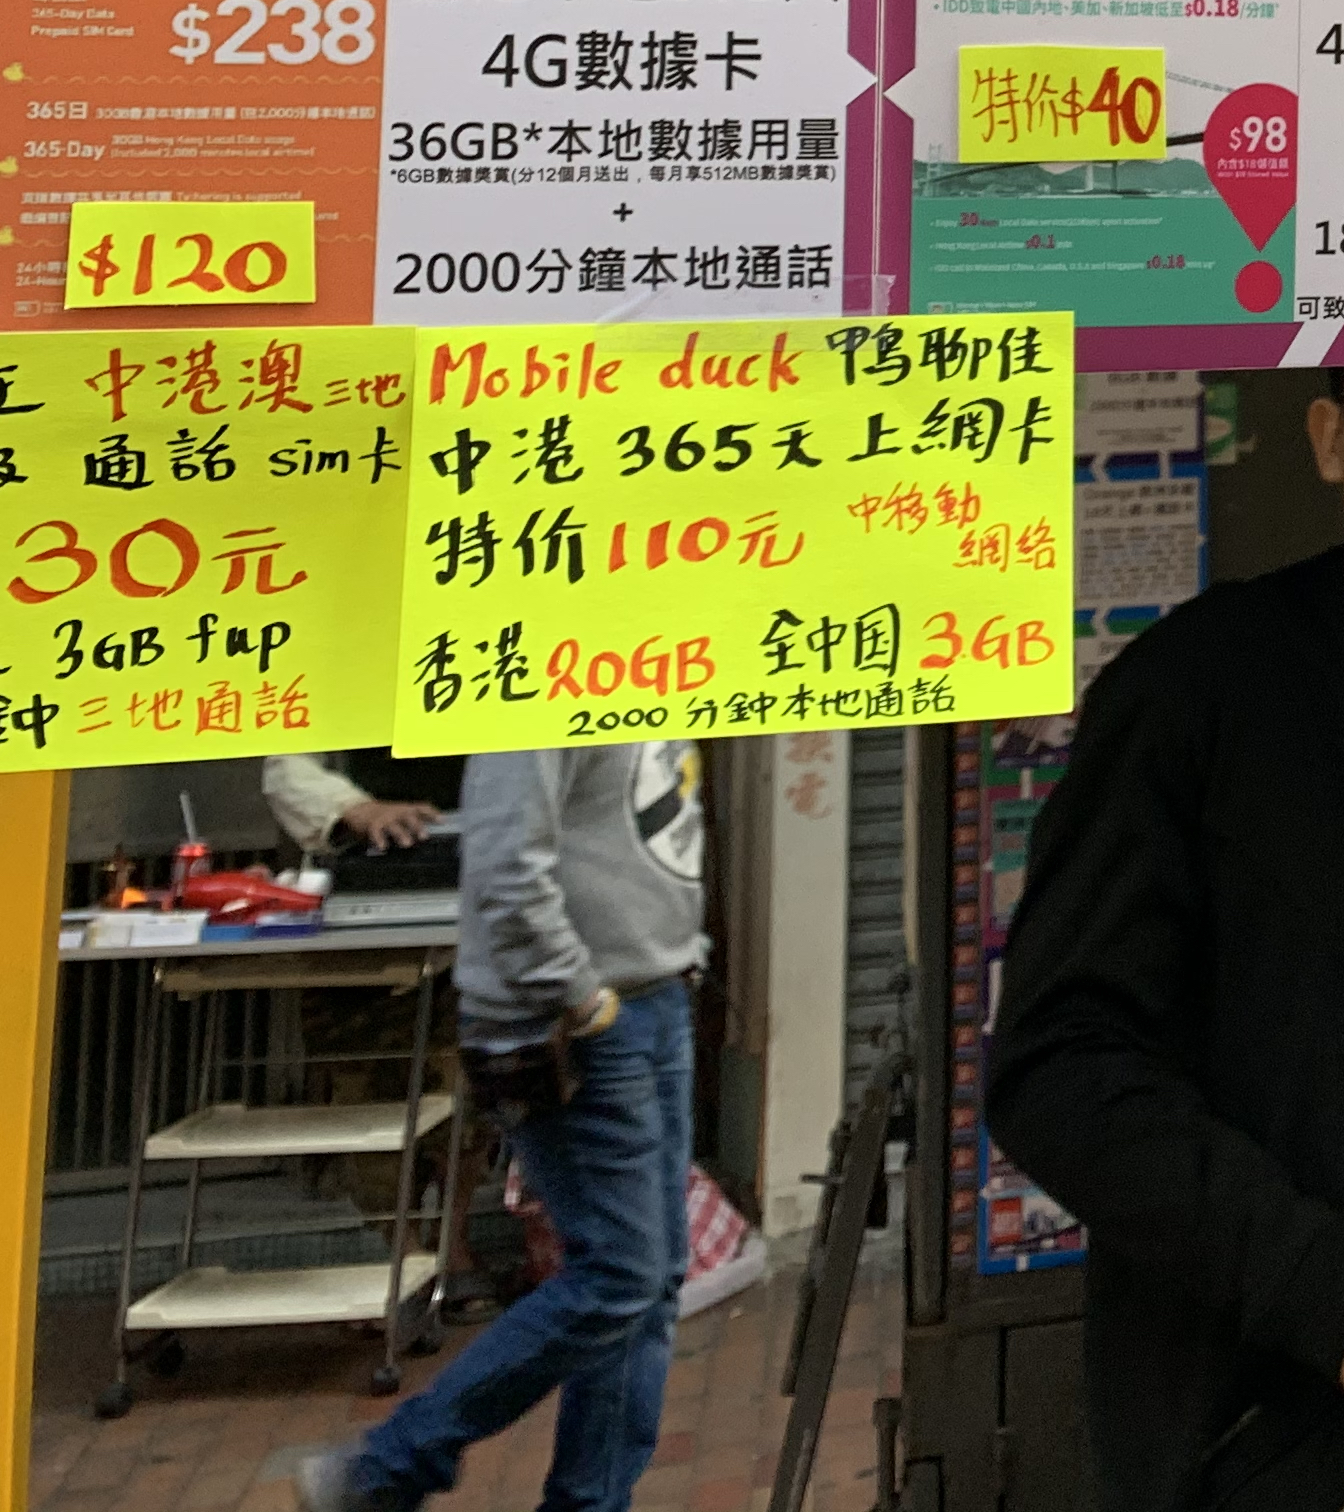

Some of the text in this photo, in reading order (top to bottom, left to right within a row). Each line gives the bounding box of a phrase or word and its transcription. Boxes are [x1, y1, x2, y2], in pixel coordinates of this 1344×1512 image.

[481, 30, 764, 93] 4G數據卡
[1228, 117, 1287, 151] $98
[79, 232, 288, 297] $120
[392, 245, 833, 295] 2000分鐘本地通話
[429, 341, 622, 409] Mobile
[660, 331, 801, 391] duck
[54, 619, 166, 680] 3GB
